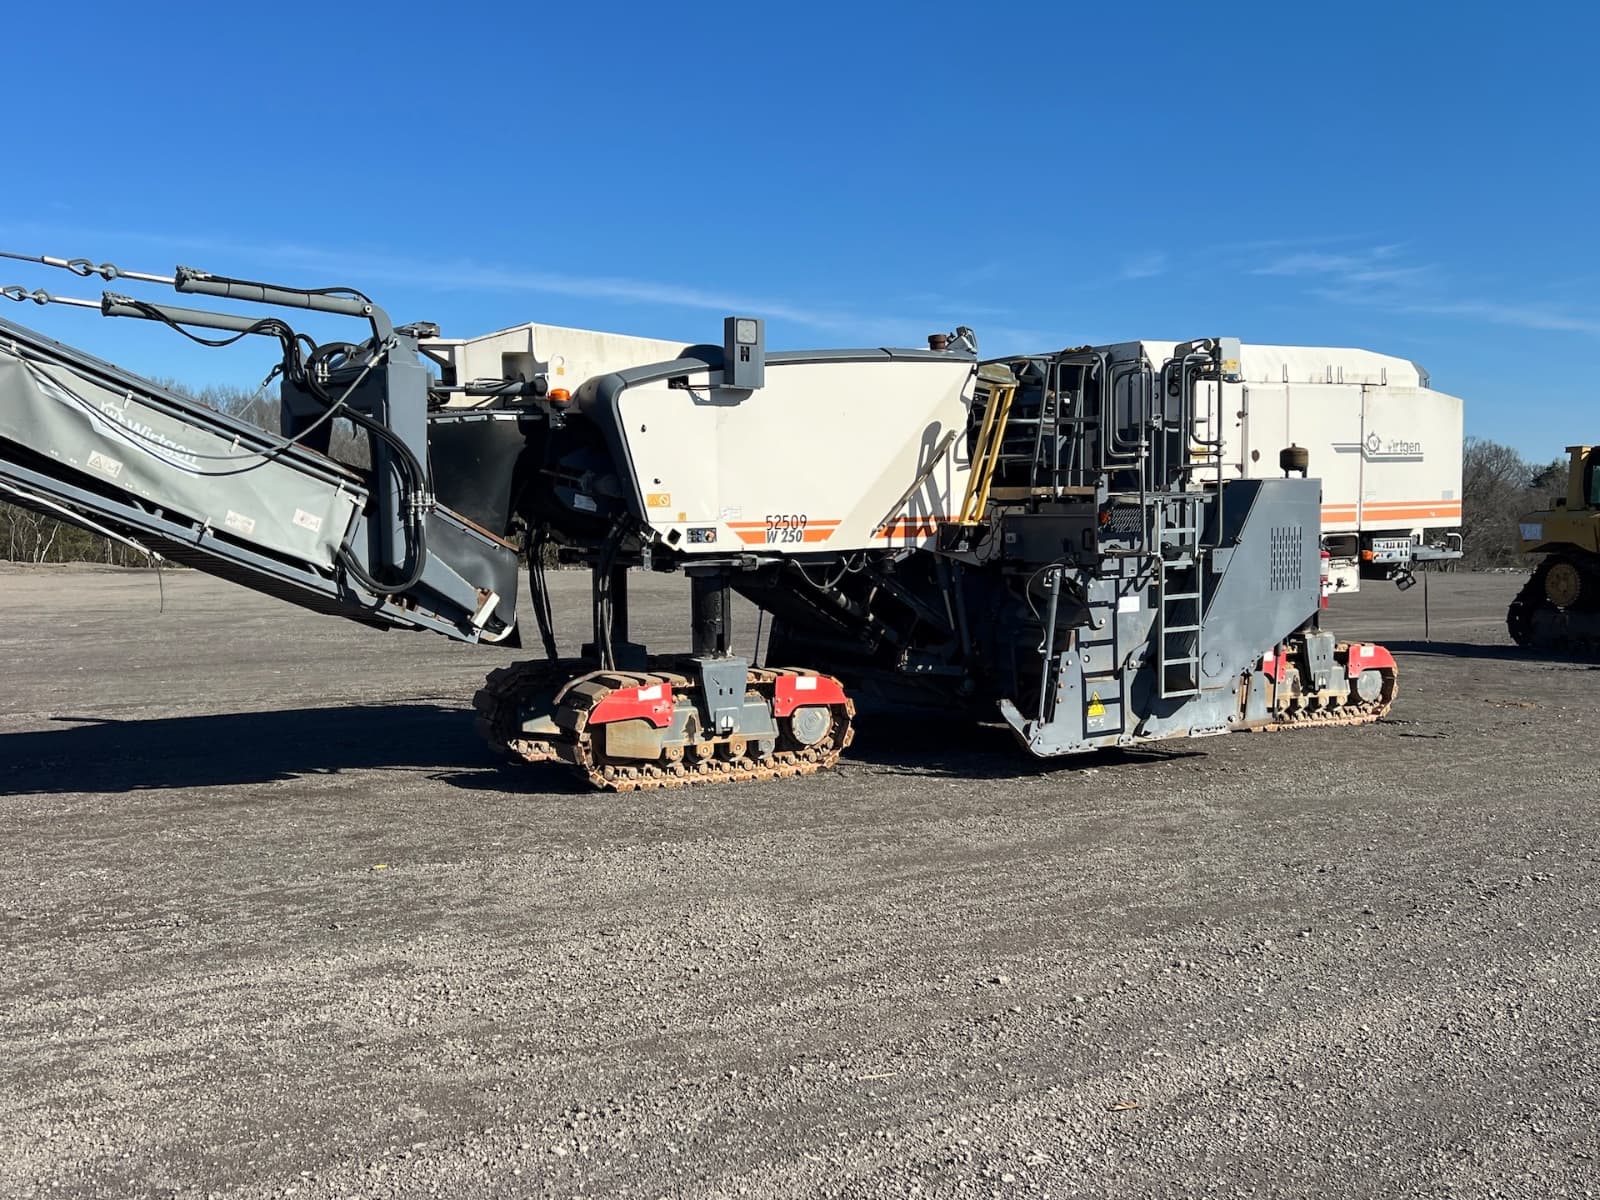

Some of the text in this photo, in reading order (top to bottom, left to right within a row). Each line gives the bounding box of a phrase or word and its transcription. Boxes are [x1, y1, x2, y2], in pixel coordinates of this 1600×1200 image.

[765, 514, 807, 530] 52509
[766, 530, 803, 543] W 250
